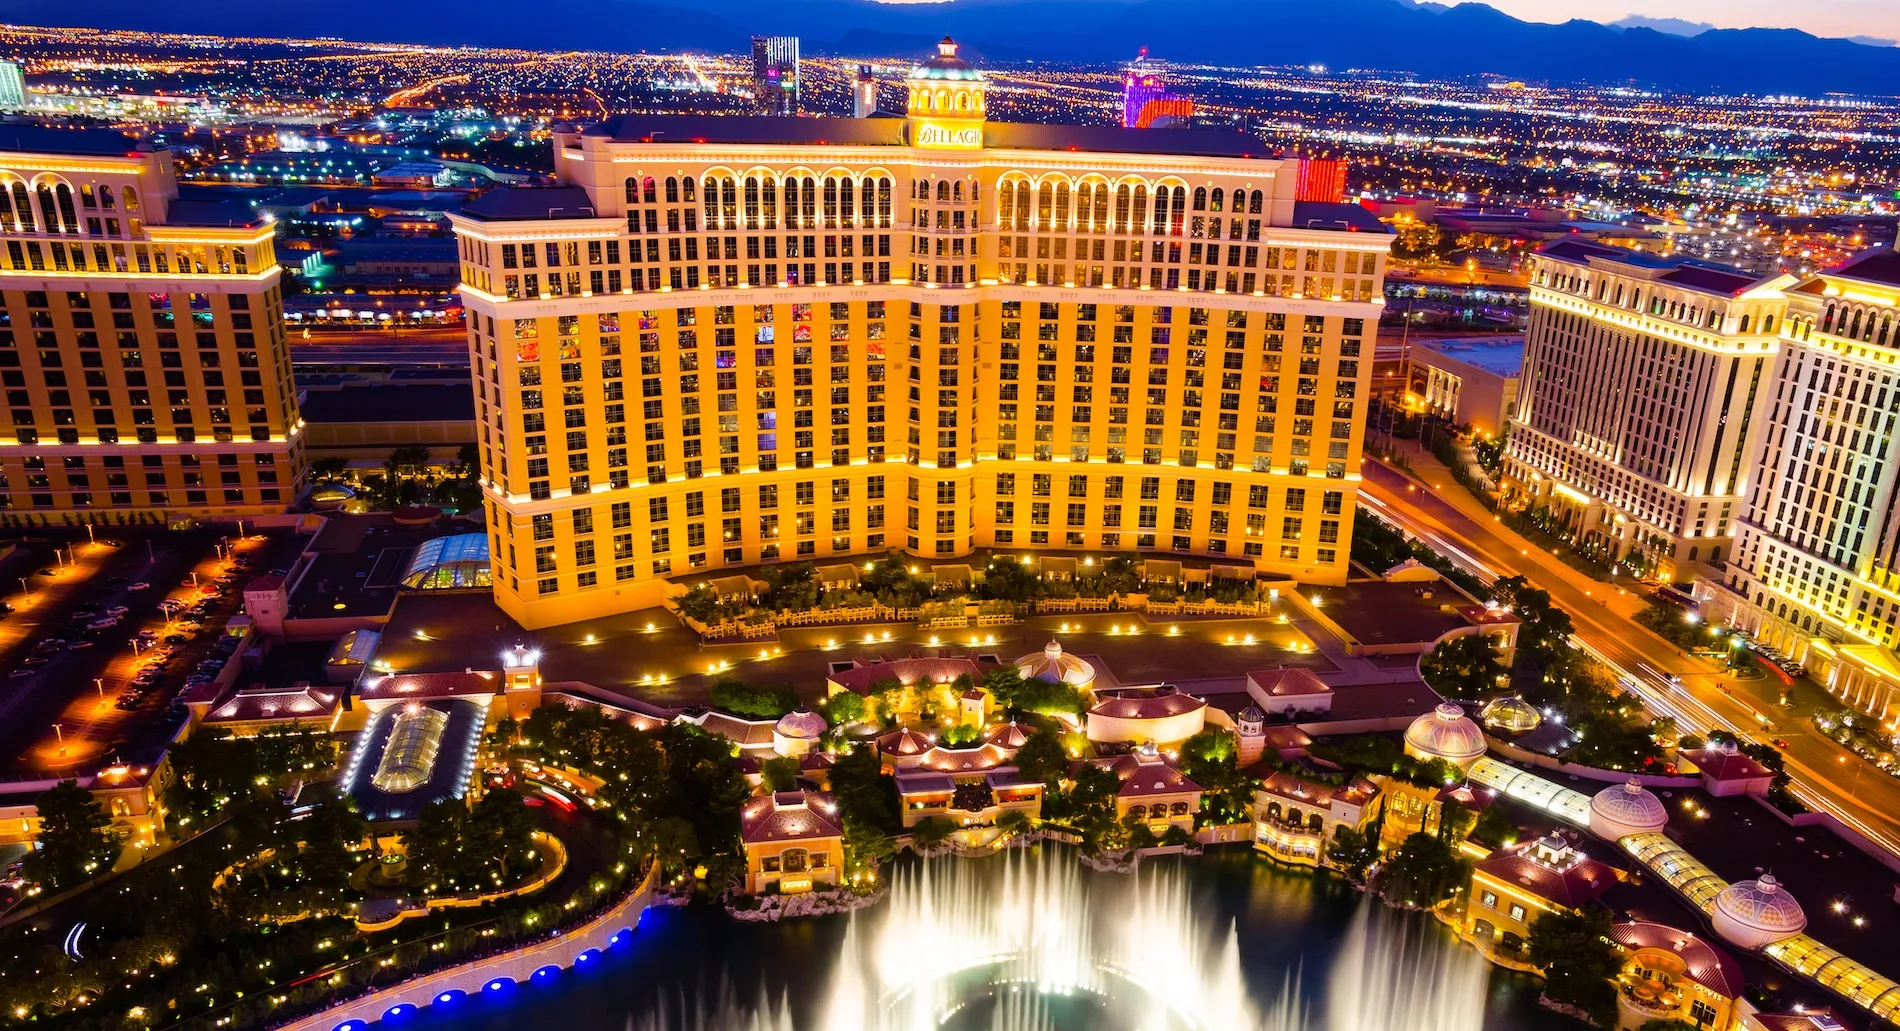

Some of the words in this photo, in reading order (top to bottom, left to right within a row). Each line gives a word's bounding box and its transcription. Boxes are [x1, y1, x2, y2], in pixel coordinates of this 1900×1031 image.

[917, 127, 983, 144] BELLAGIO
[1599, 935, 1625, 953] OLIVES
[1693, 983, 1722, 1002] OLIVES
